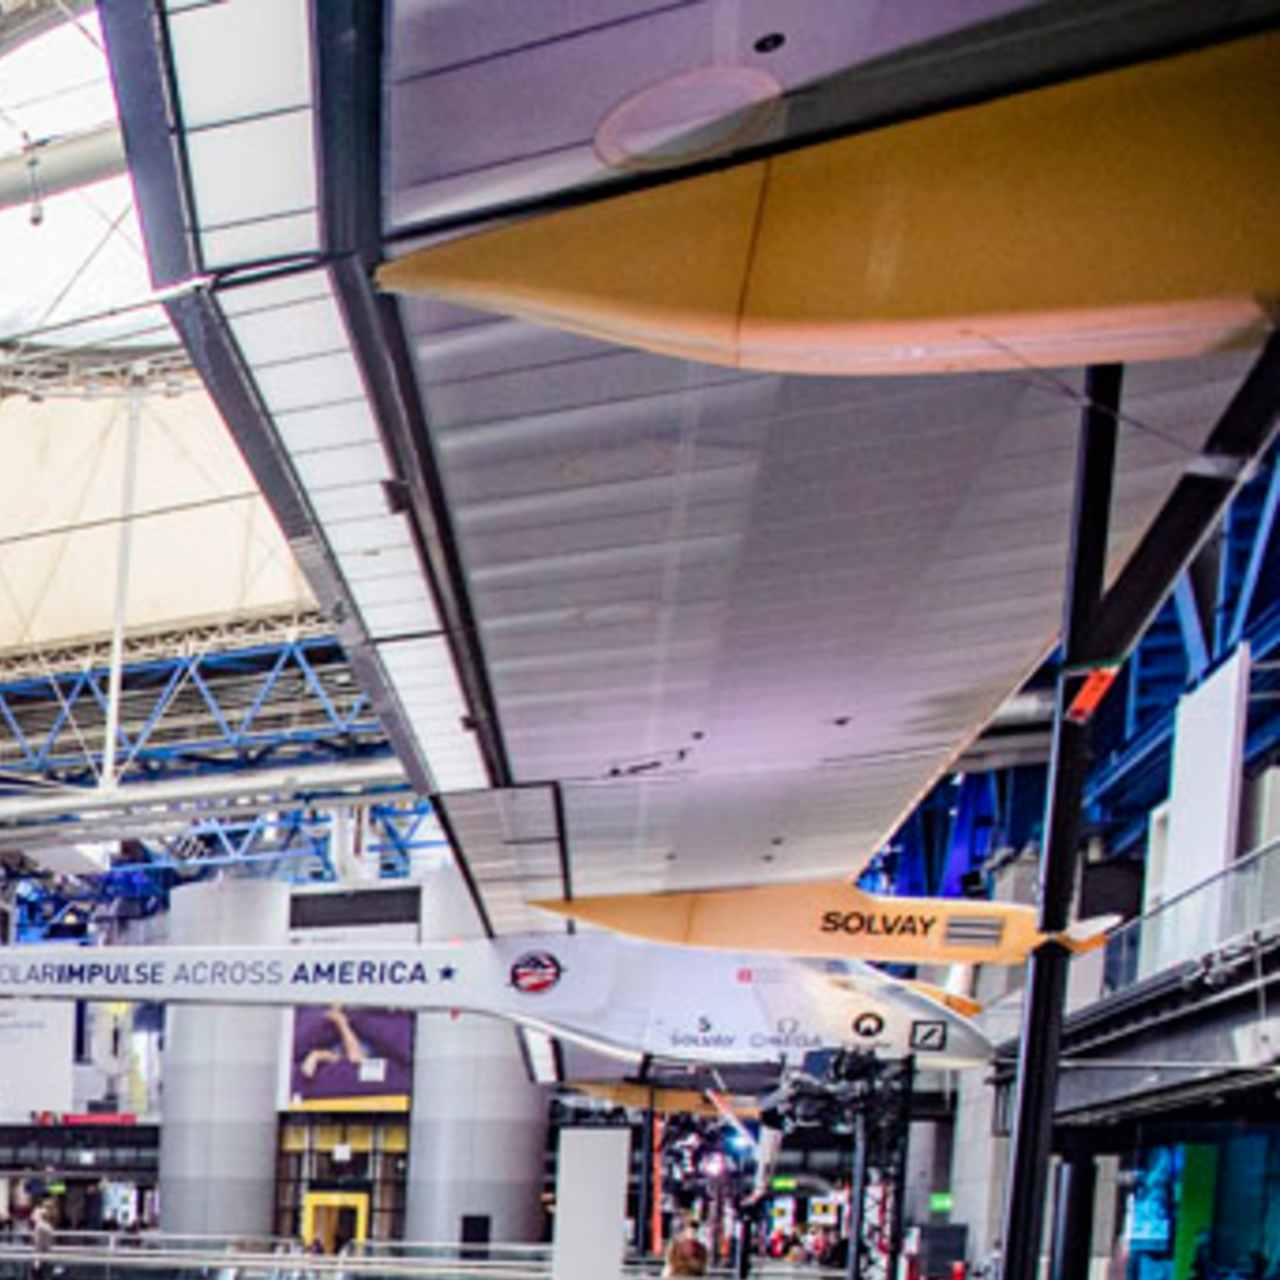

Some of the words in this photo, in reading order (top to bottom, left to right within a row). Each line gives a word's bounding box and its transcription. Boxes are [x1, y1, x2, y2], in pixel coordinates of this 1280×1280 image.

[821, 911, 936, 936] SOLVAY
[173, 961, 283, 985] ACROSS
[291, 960, 428, 984] AMERICA
